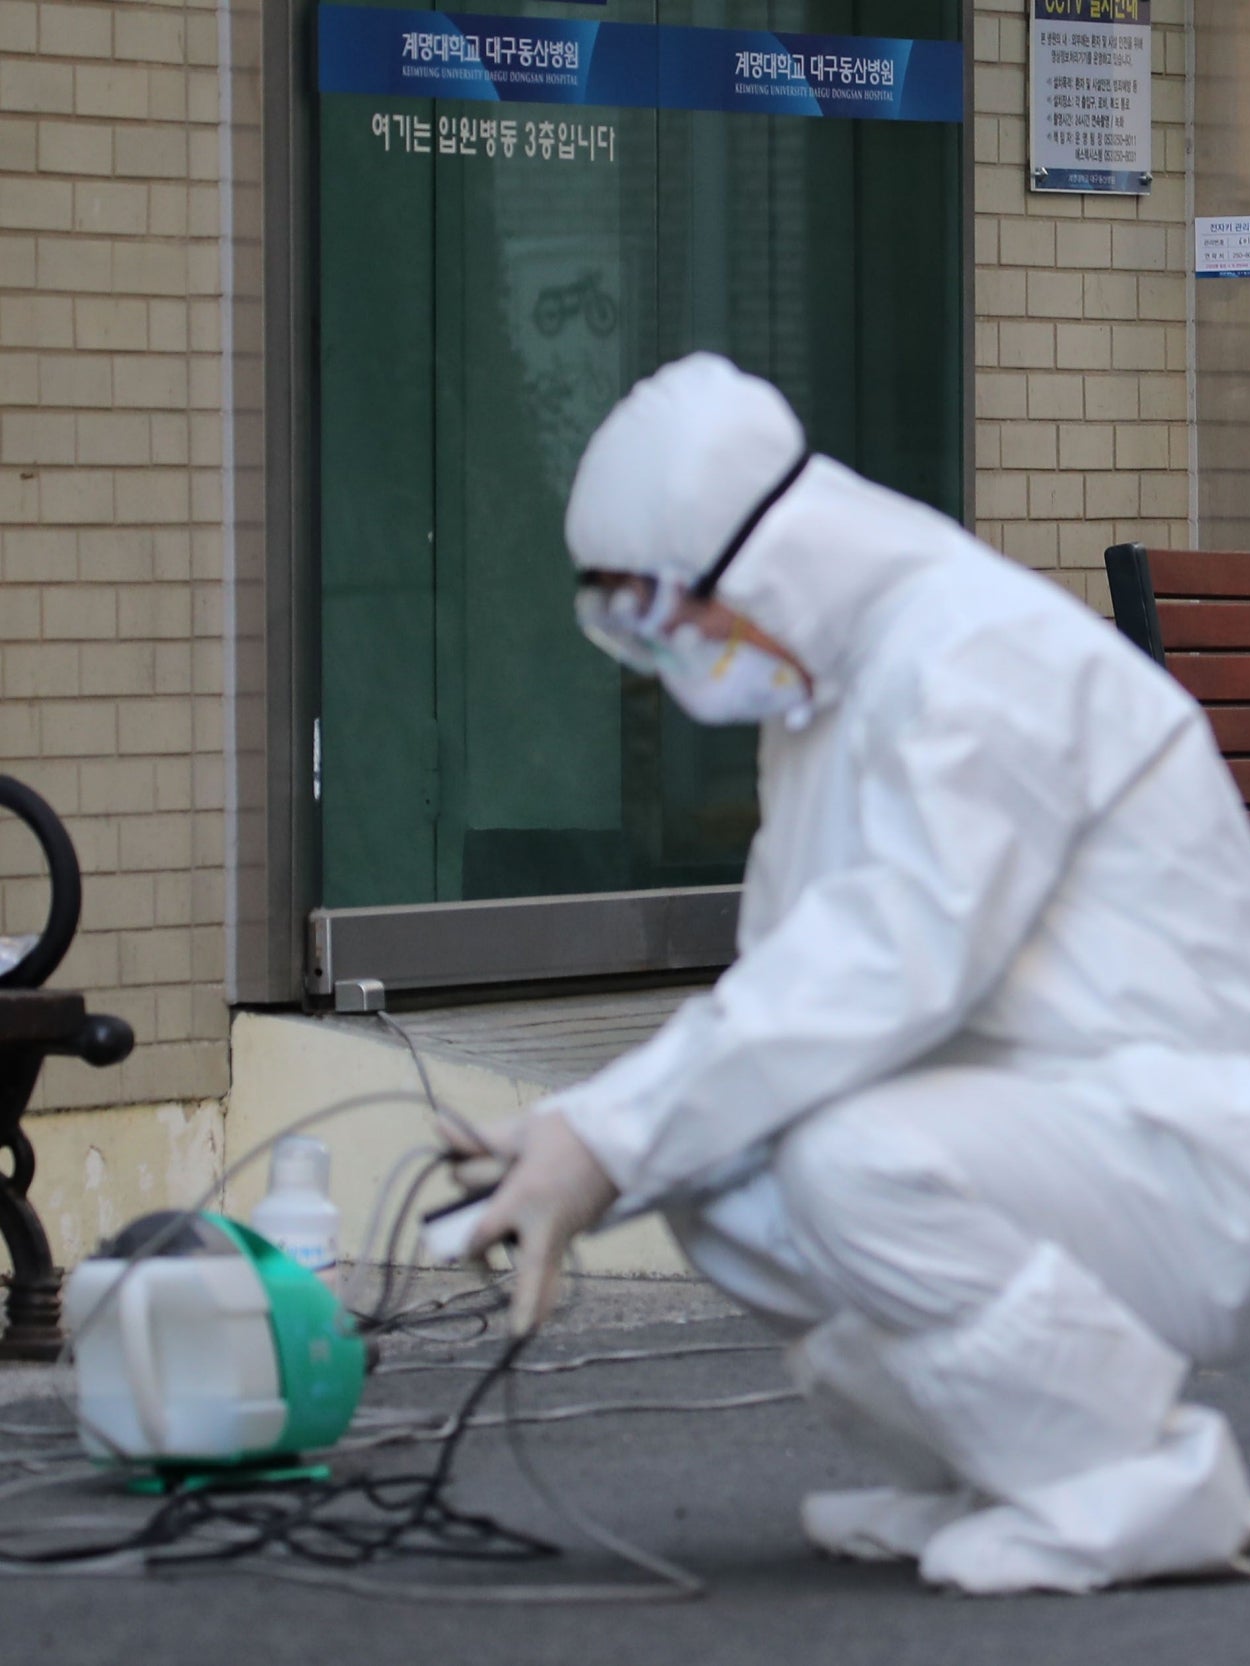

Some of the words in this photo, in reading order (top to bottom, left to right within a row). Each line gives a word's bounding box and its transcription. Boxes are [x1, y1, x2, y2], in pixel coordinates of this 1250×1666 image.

[402, 32, 480, 62] 계명대학교
[486, 36, 579, 69] 대구동산병원
[402, 65, 439, 79] KEIMYUNG
[441, 67, 482, 81] UNIVERSITY
[484, 70, 507, 82] DAEGU
[510, 71, 543, 83] DONGSAN
[546, 72, 578, 86] HOSPITAL
[735, 51, 805, 80] 계명대학교
[810, 54, 894, 86] 대구동산병원
[735, 84, 768, 96] KEIMYUNG
[770, 85, 808, 98] UNIVERSITY
[809, 87, 831, 99] DAEGU
[832, 88, 862, 100] DONGSAN
[864, 89, 894, 102] HOSPITAL
[371, 112, 431, 153] 여기는
[438, 116, 517, 158] 입원병동
[524, 120, 615, 163] 3층입니다
